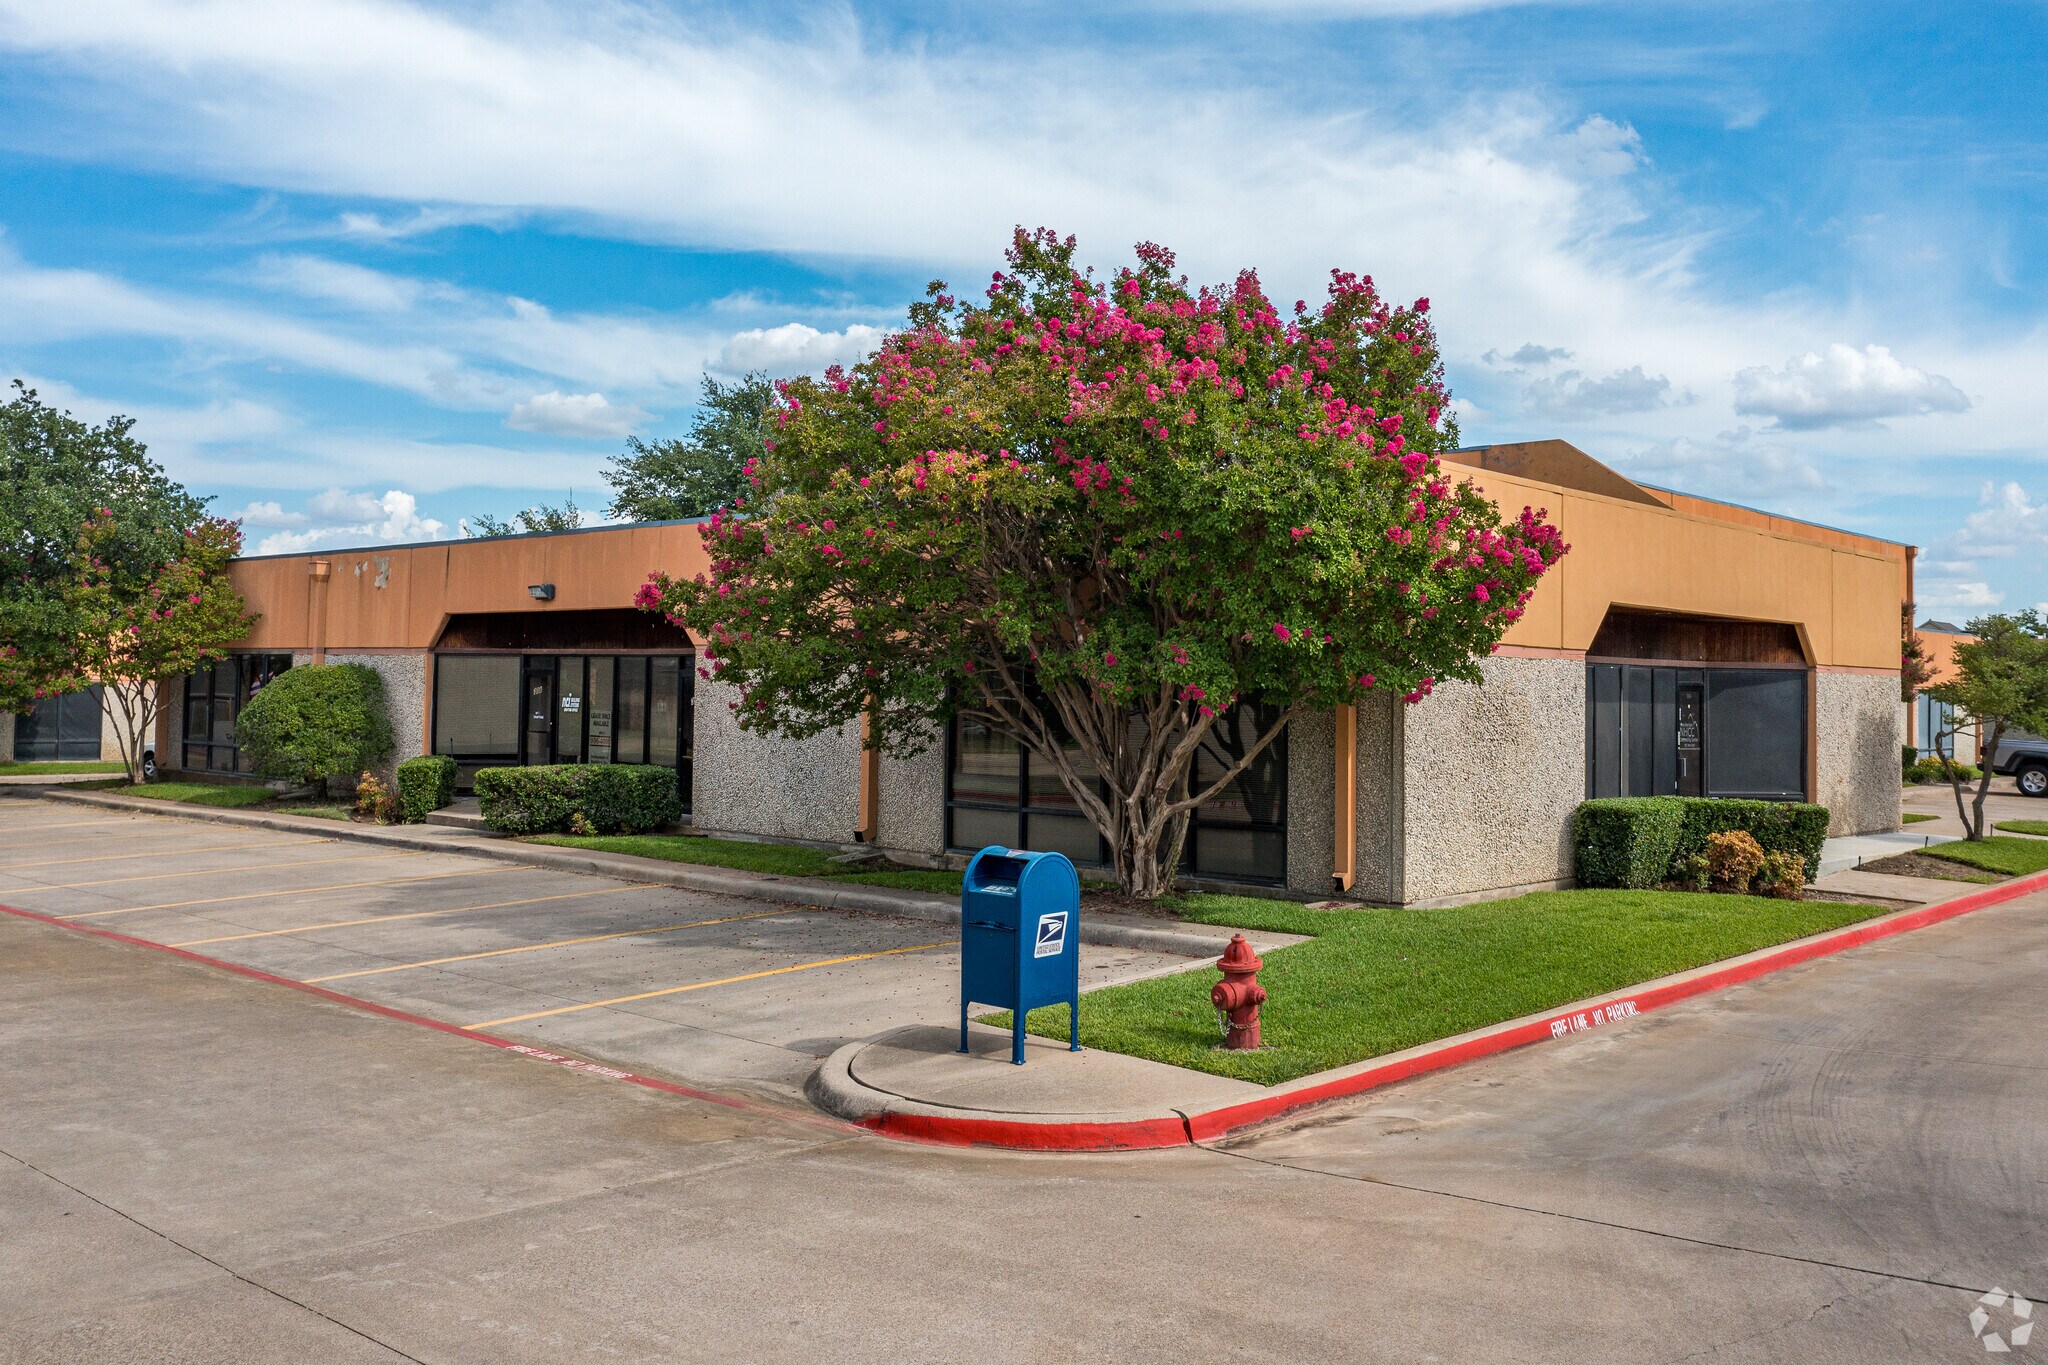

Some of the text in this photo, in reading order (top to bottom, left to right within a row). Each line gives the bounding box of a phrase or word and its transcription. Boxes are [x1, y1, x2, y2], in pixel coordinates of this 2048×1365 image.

[1568, 1013, 1591, 1033] LANE
[1592, 1008, 1606, 1026] NO
[1605, 1001, 1641, 1023] PARKING
